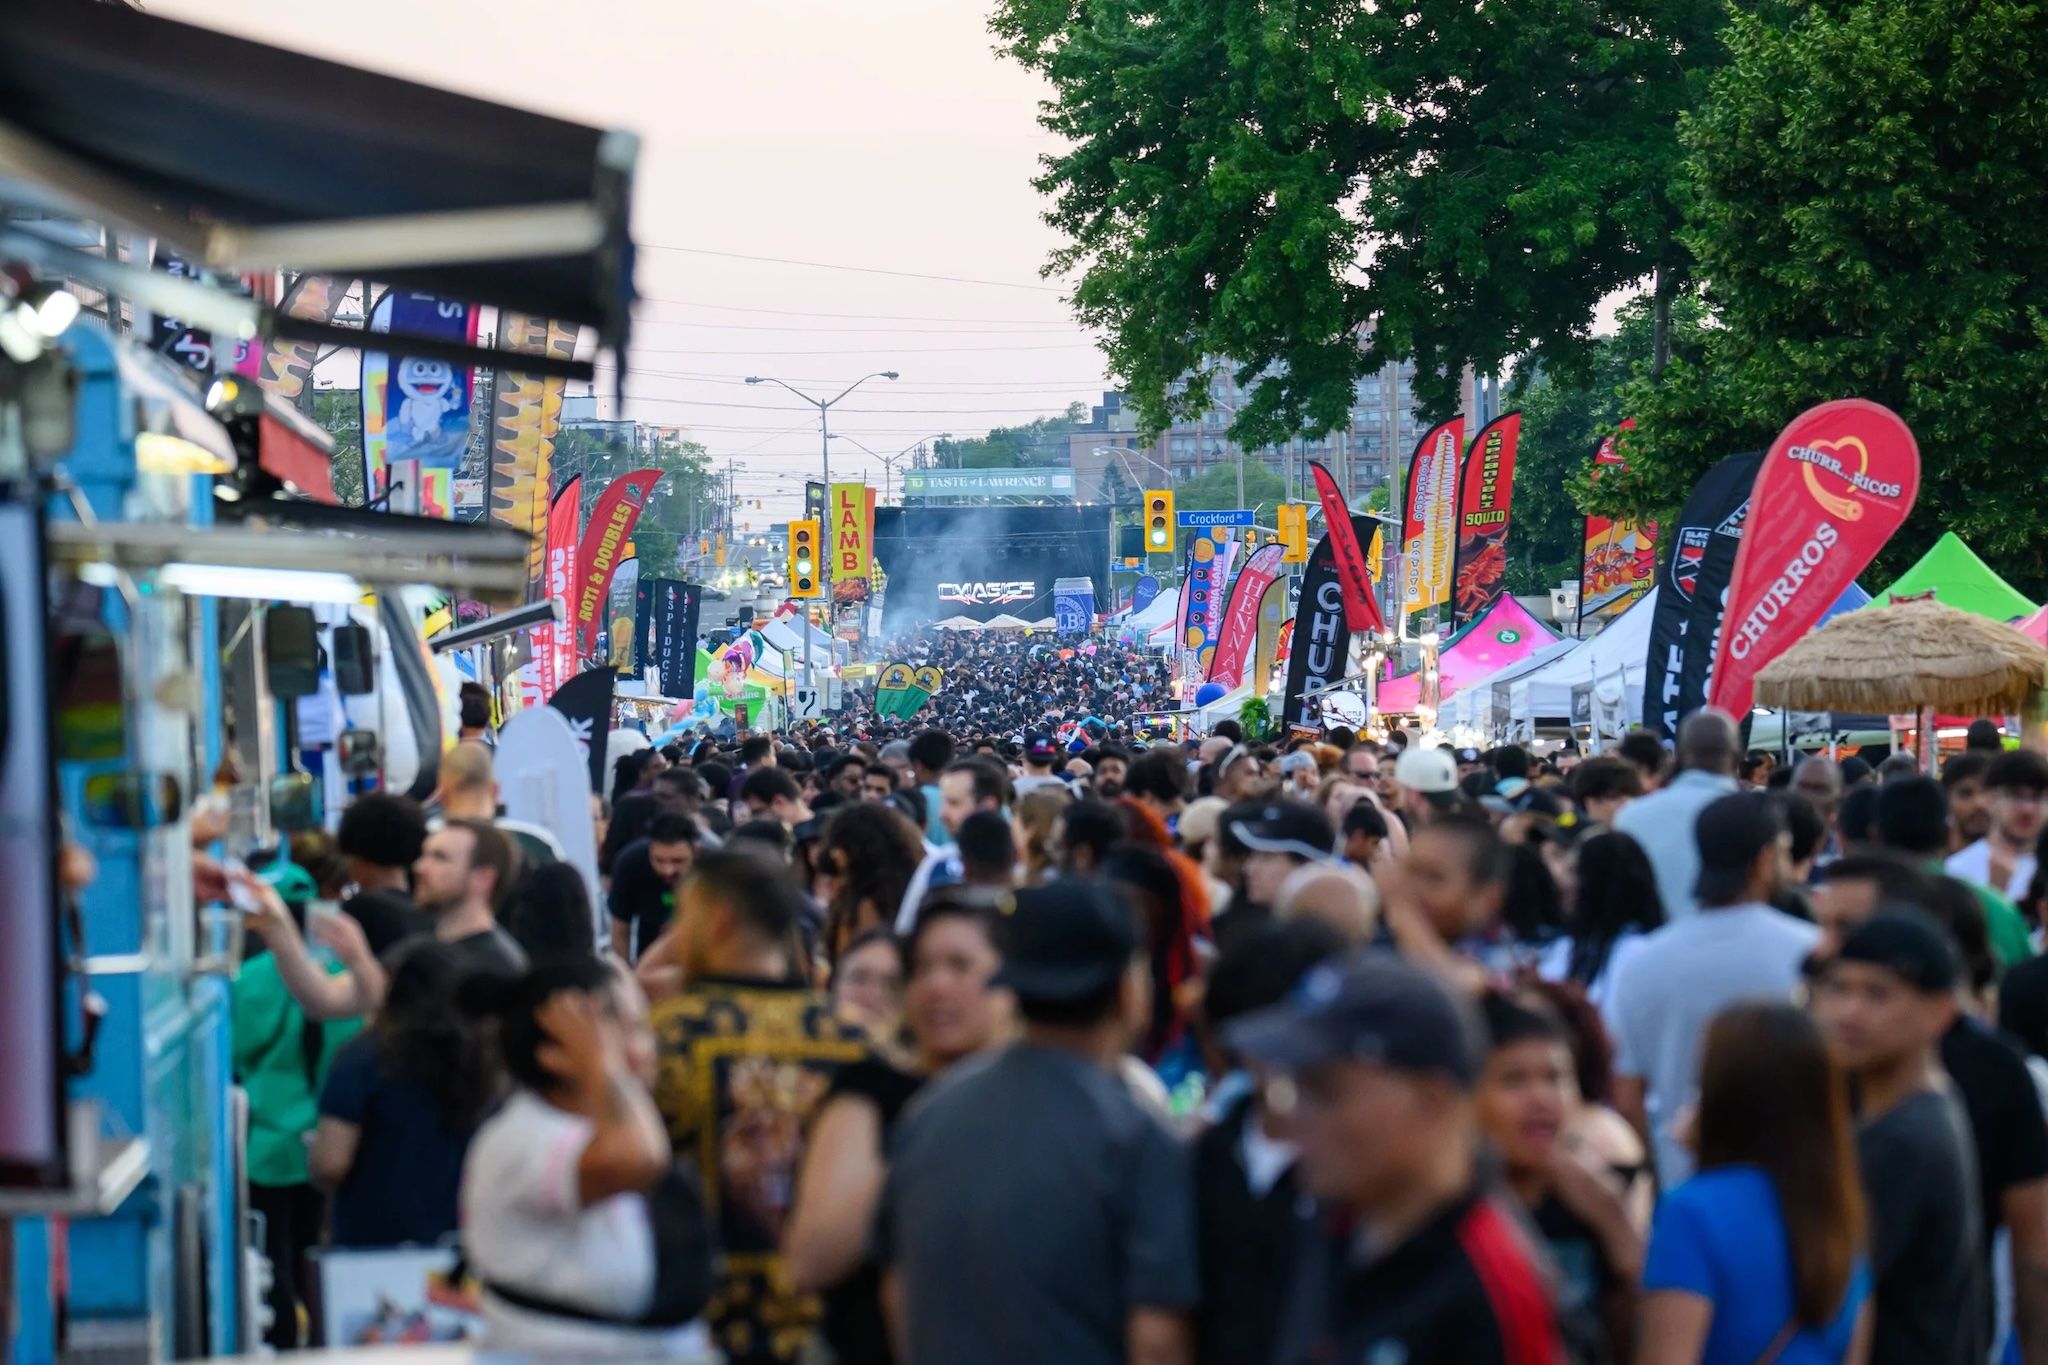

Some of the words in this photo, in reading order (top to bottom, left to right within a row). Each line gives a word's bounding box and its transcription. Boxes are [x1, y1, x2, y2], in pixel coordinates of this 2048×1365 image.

[910, 478, 924, 488] TD
[928, 477, 968, 488] TASTE
[978, 476, 1046, 488] LAWRENCE
[1414, 456, 1430, 521] TORNADO
[839, 490, 861, 571] LAMB
[1189, 513, 1235, 525] Crockford
[1465, 510, 1505, 527] SQUID
[578, 585, 601, 622] ROTI
[590, 572, 605, 584] &
[599, 503, 633, 571] DOUBLES
[1212, 554, 1224, 588] GAME
[1409, 540, 1421, 595] POTATO
[1207, 589, 1221, 641] DALGONA
[1730, 522, 1838, 661] CHURROS
[1222, 575, 1265, 670] HENNA
